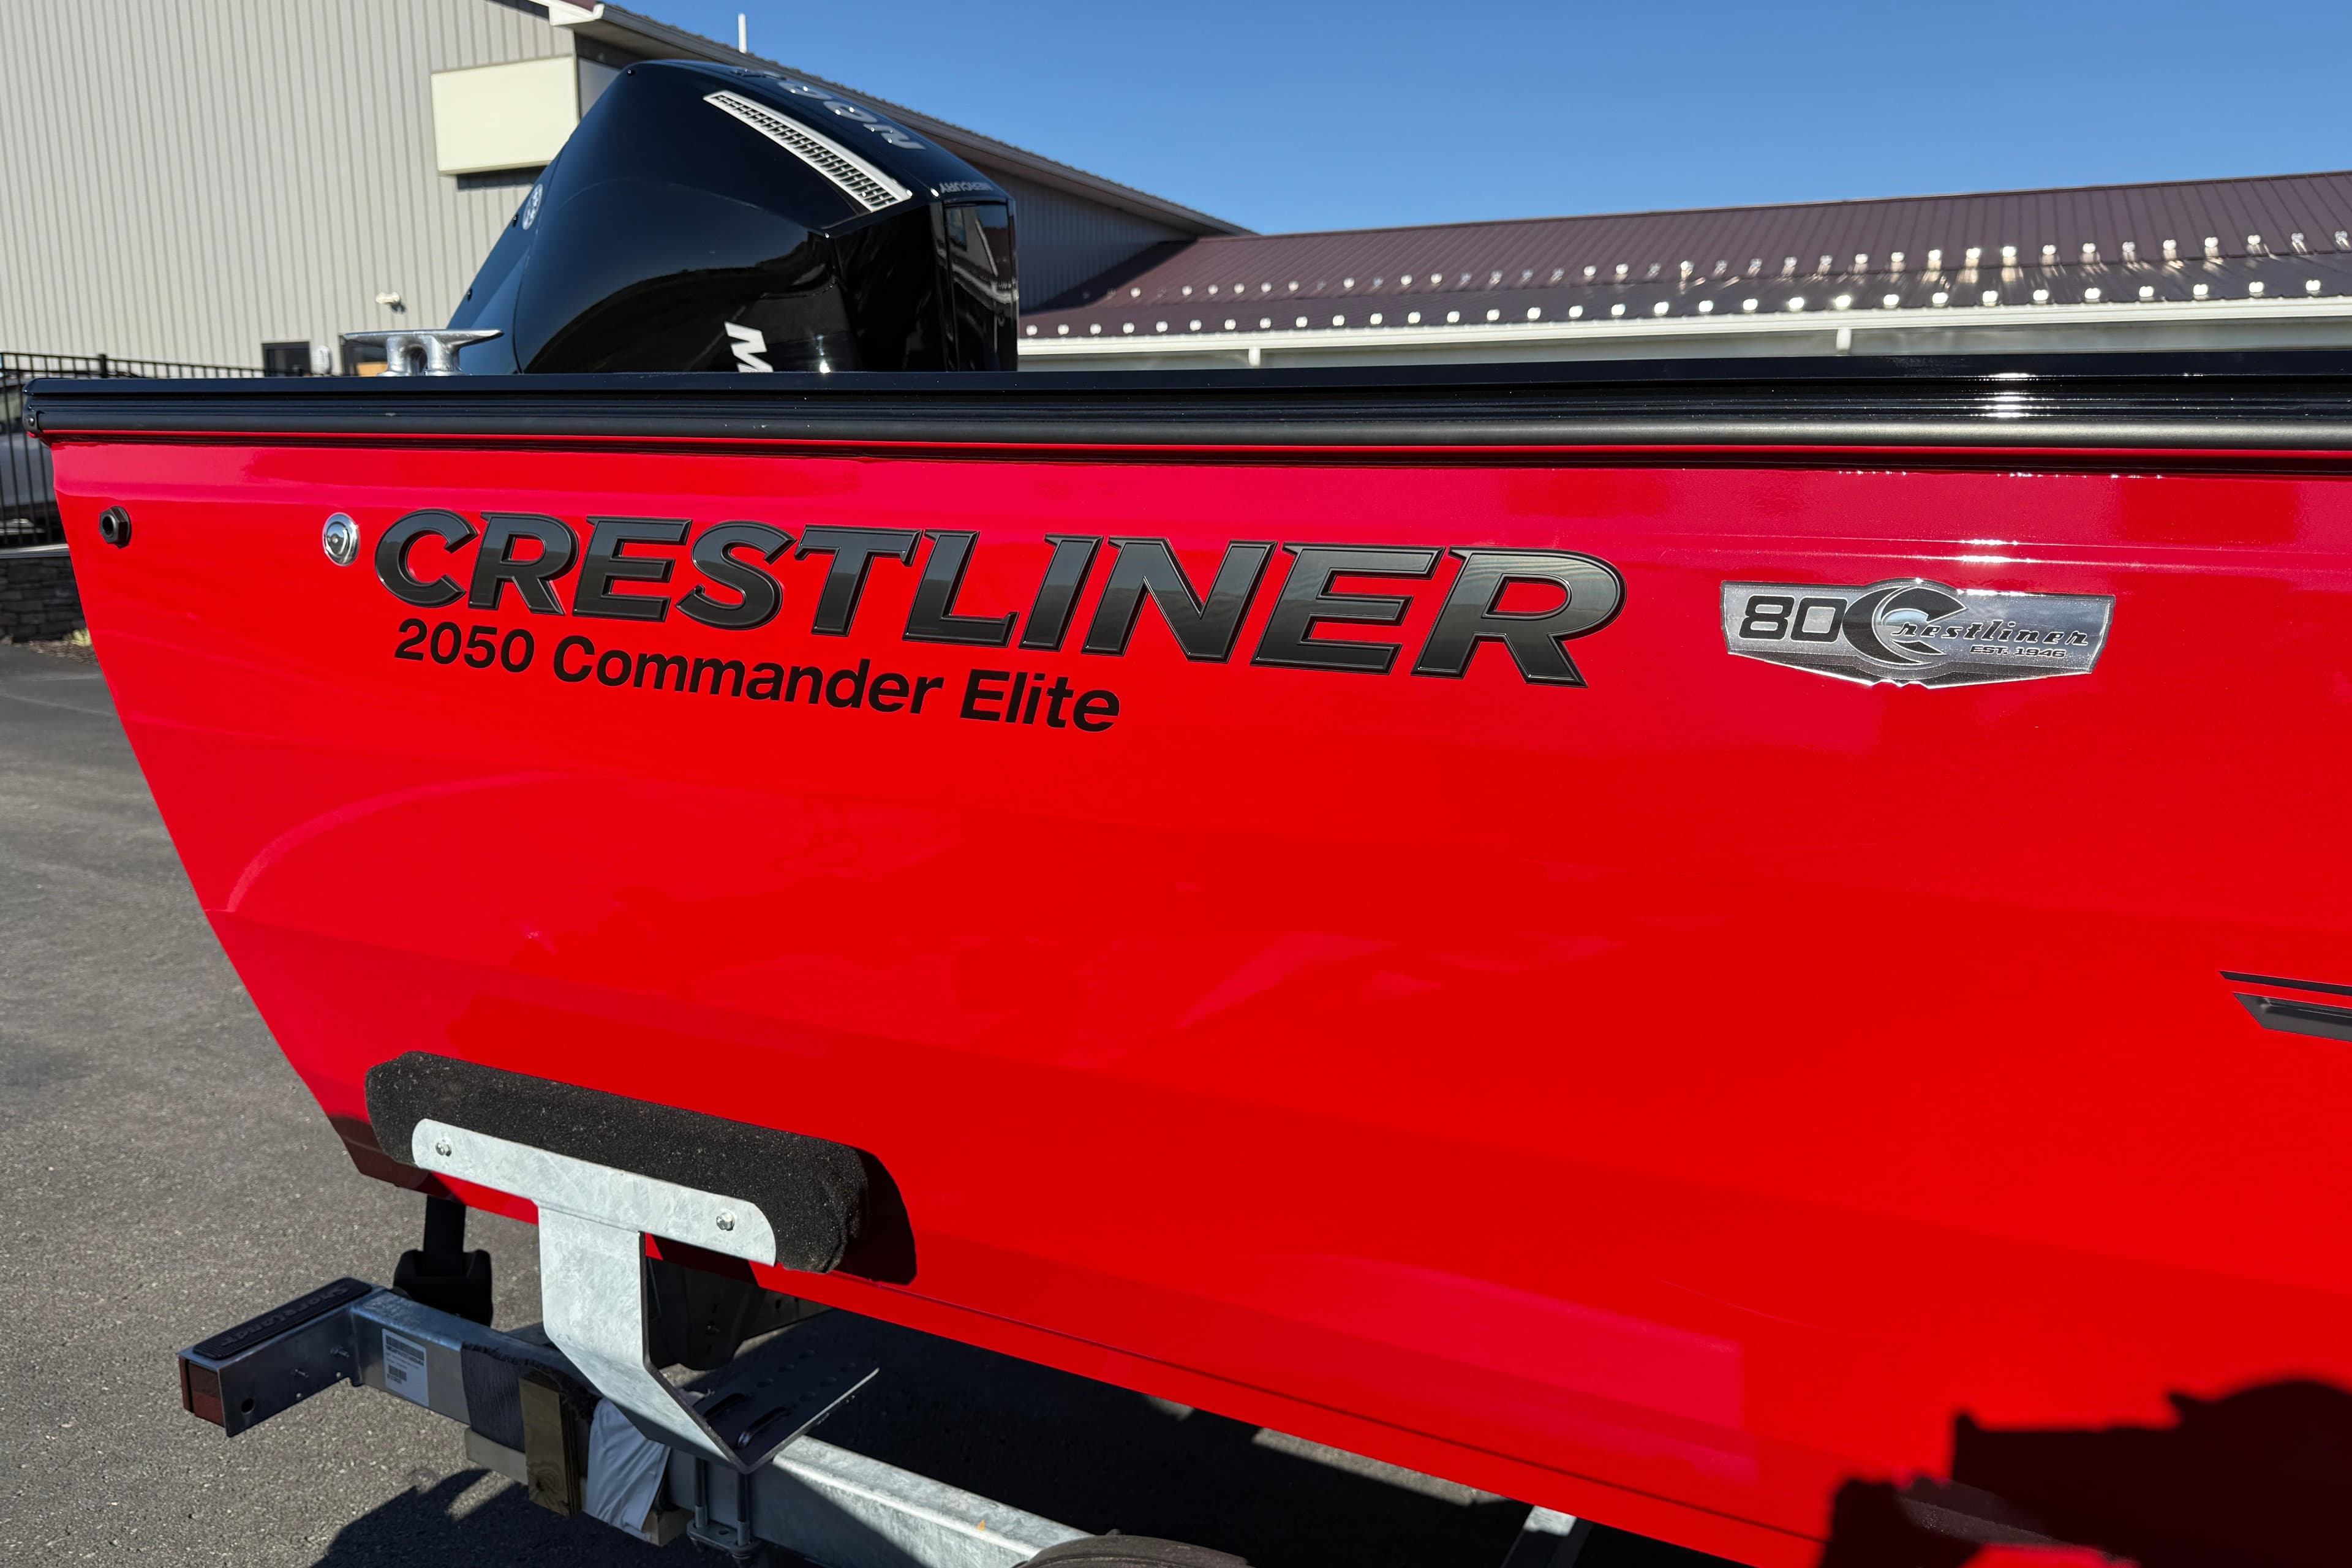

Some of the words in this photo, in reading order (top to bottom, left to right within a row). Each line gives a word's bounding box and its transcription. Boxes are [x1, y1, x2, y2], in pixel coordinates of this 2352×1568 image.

[374, 508, 1627, 688] CRESTLINER
[1738, 595, 1849, 643] 80
[394, 618, 535, 673] 2050
[553, 635, 944, 714] Commander
[960, 669, 1120, 732] Elite
[1969, 644, 2008, 655] EST.
[2015, 646, 2066, 658] 1946
